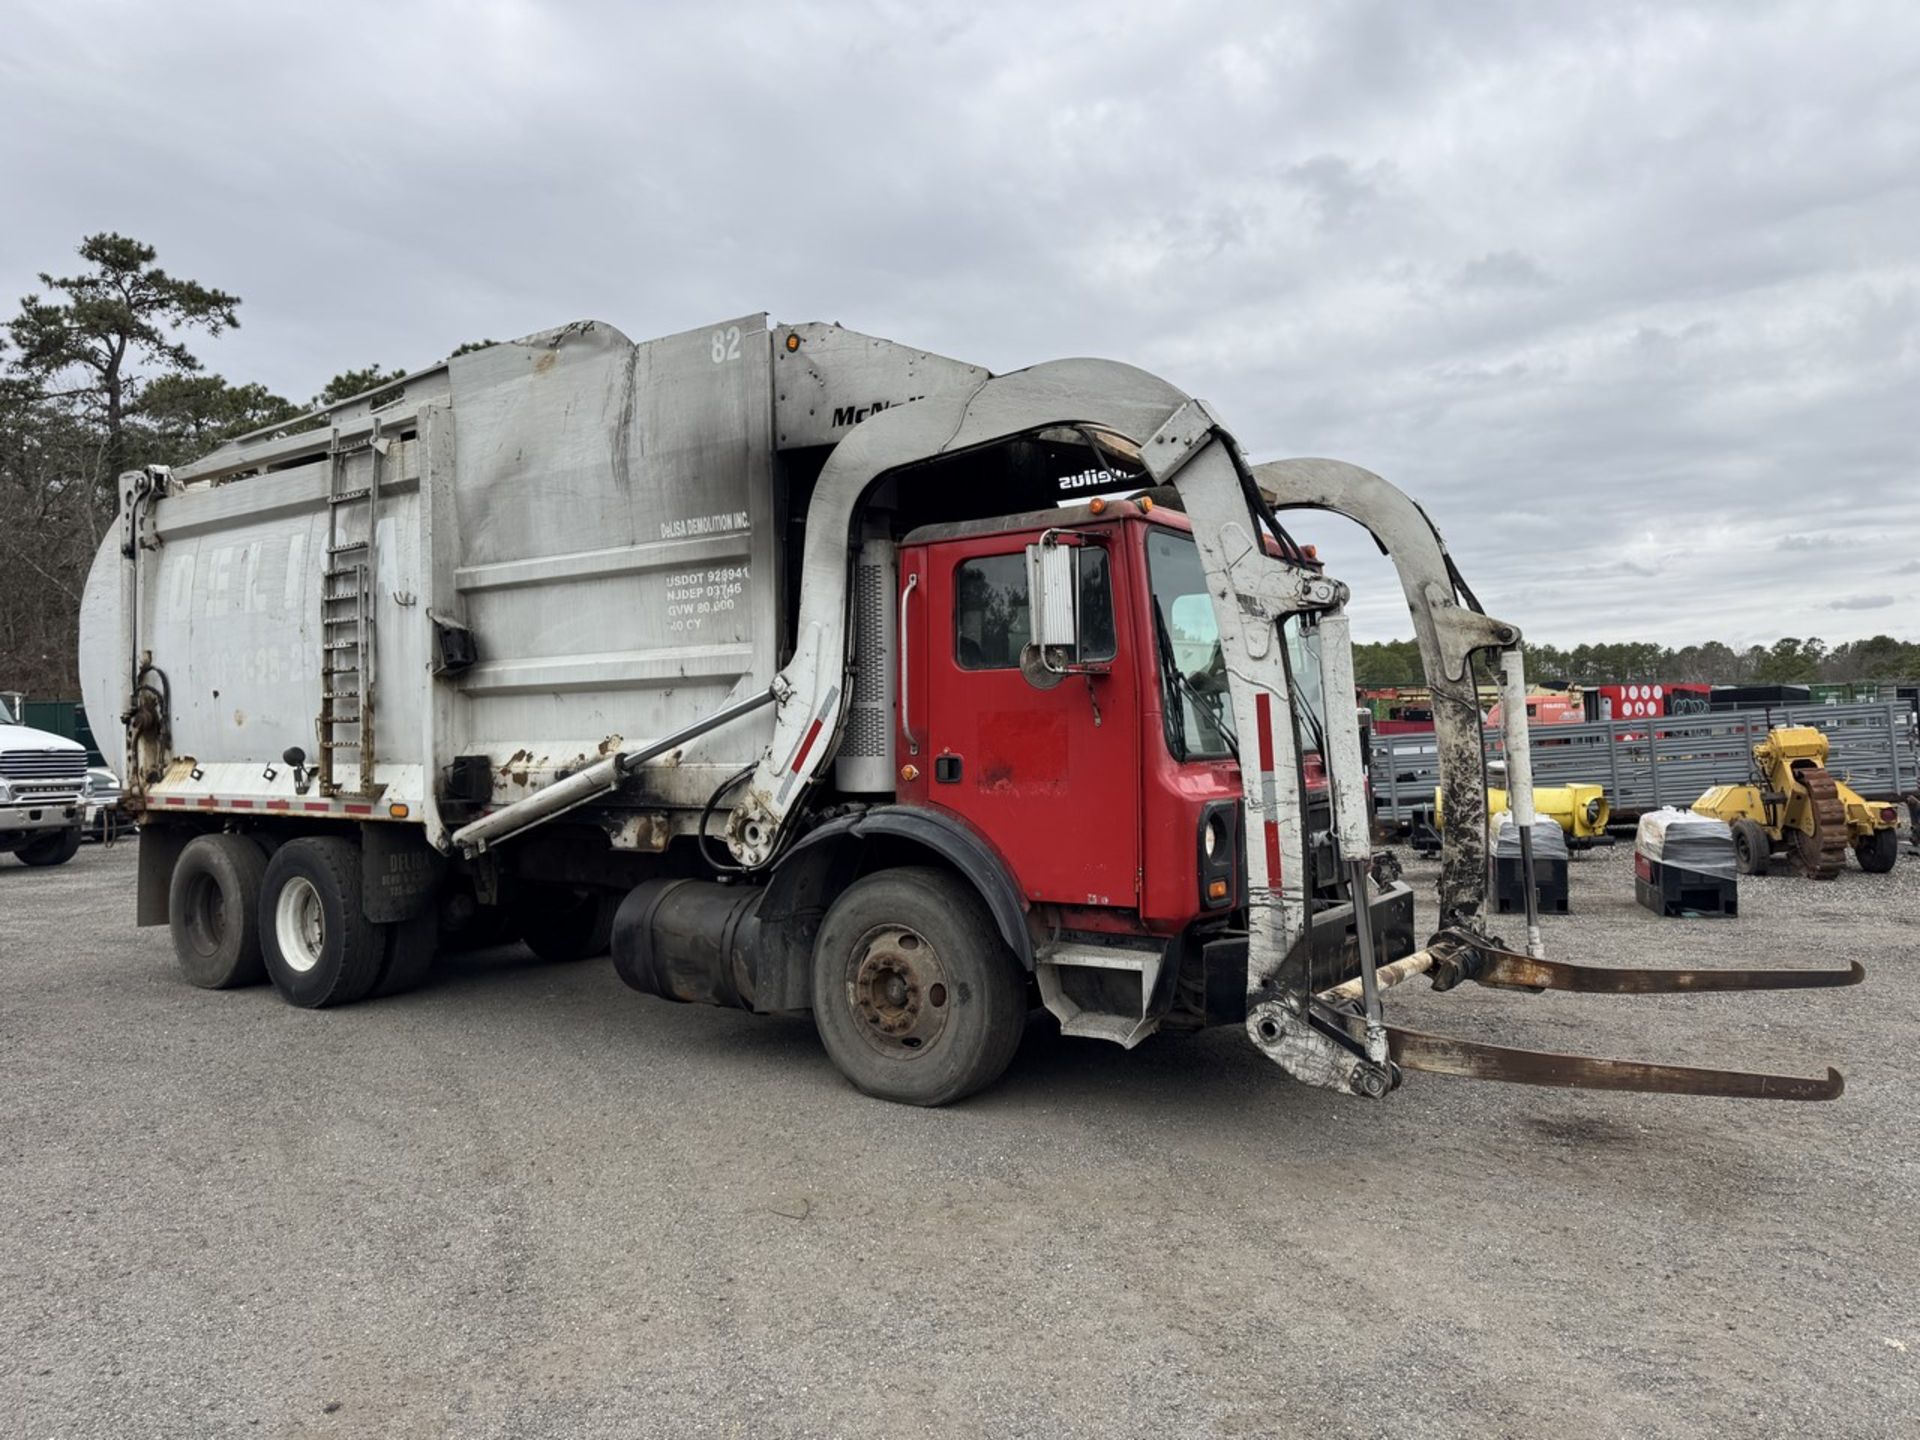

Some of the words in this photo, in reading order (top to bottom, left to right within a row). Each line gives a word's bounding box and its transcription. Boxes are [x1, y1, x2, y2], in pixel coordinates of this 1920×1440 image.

[711, 326, 741, 363] 82
[686, 514, 733, 535] DEMOLITION
[733, 511, 750, 530] INC.
[666, 572, 704, 587] USDOT
[667, 587, 703, 600] NJDEP
[668, 603, 694, 616] GVW
[686, 619, 701, 630] CY
